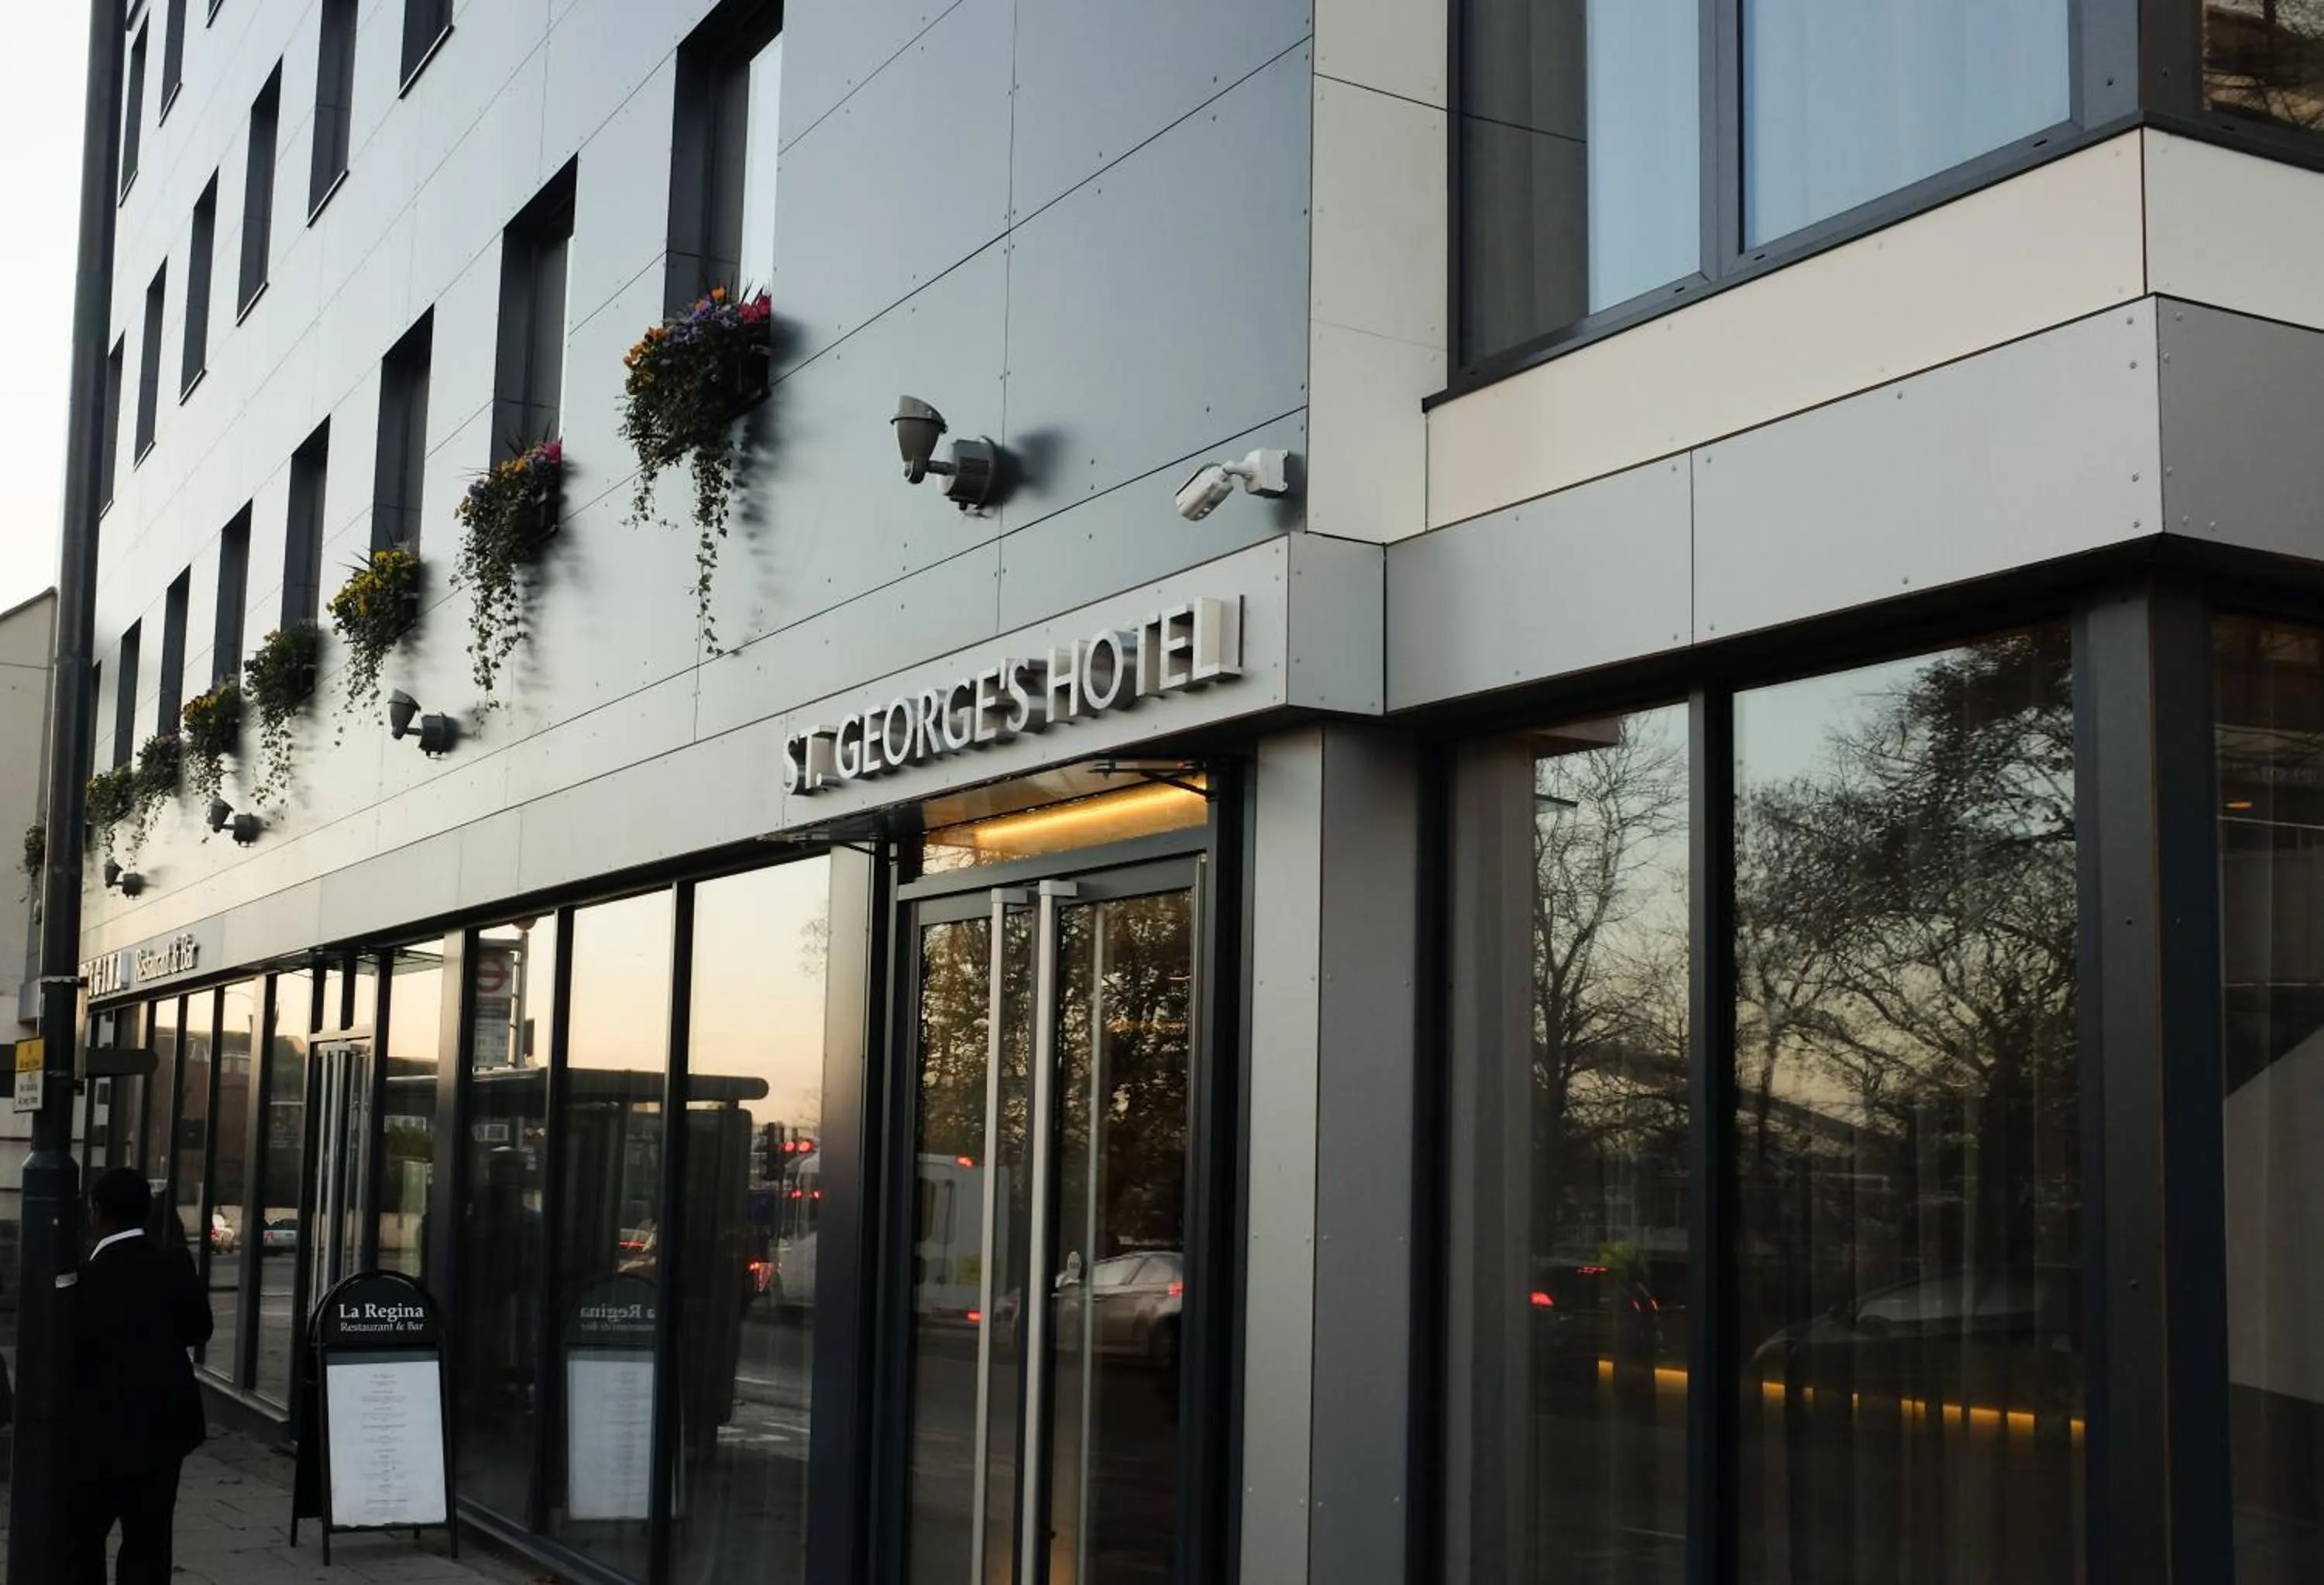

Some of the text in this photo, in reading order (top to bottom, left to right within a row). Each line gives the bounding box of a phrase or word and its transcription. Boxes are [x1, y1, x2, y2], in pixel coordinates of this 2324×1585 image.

[783, 596, 1243, 796] ST. GEORGE'S HOTEL
[339, 1302, 425, 1322] La Regina
[340, 1321, 425, 1332] Restaurant & Bar
